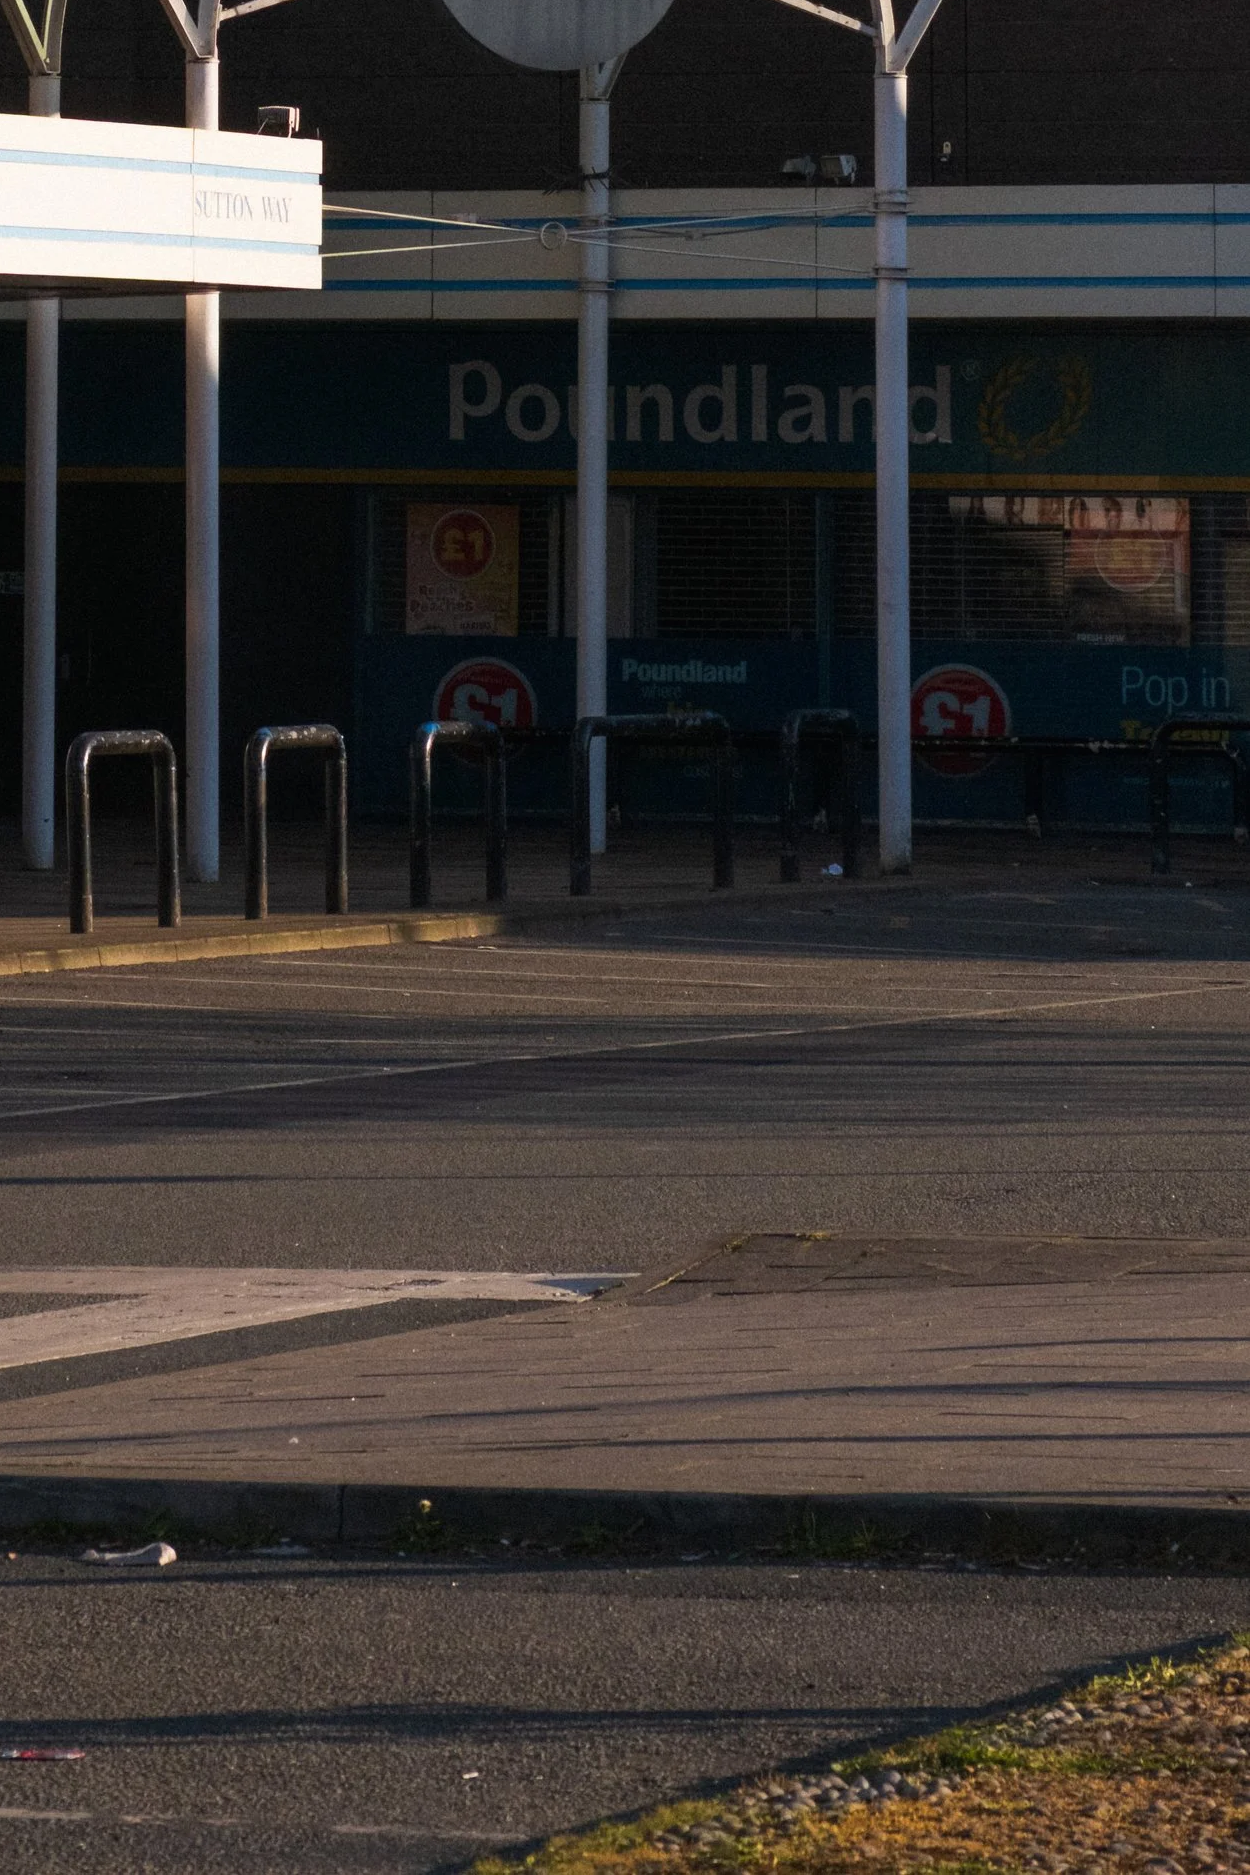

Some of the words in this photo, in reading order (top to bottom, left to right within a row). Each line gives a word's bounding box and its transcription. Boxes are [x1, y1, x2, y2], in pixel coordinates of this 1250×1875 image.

[195, 190, 253, 221] SUTTON
[261, 196, 292, 223] WAY
[440, 527, 486, 561] £1
[621, 657, 748, 685] Poundland
[1121, 665, 1189, 715] Pop
[1202, 666, 1230, 708] in
